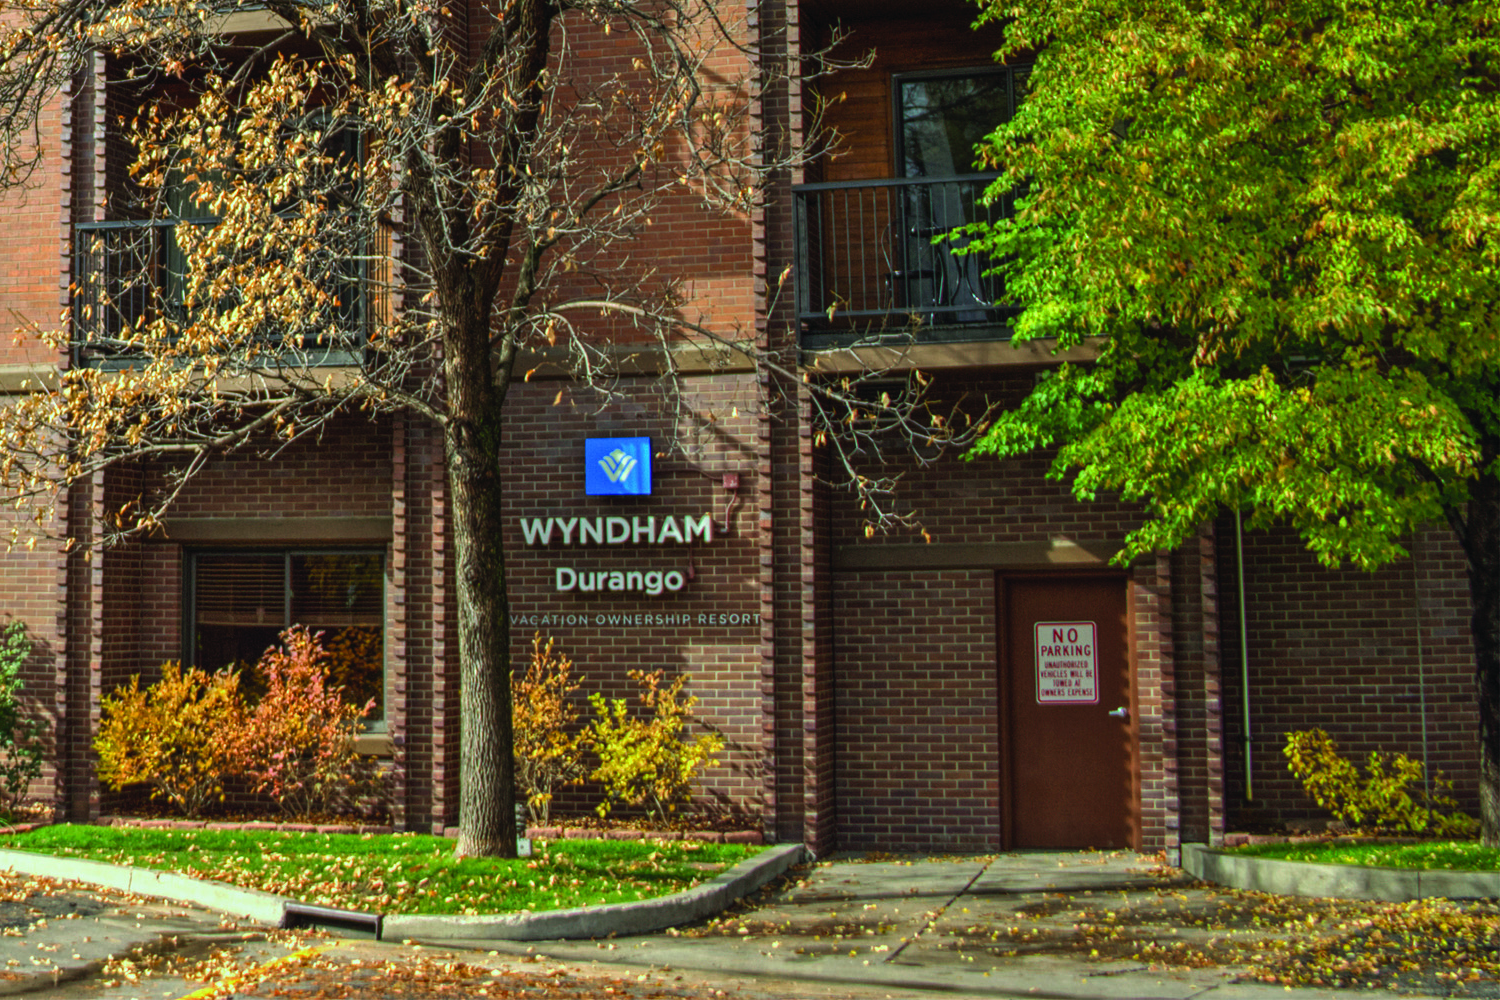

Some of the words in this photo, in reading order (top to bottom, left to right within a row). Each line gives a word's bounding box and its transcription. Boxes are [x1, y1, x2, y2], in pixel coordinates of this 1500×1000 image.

[520, 514, 713, 545] WYNDHAM
[555, 567, 684, 595] Durango
[509, 614, 588, 625] VACATION
[595, 614, 691, 625] OWNERSHIP
[698, 613, 761, 625] RESORT
[1052, 628, 1078, 643] NO
[1040, 645, 1091, 656] PARKING
[1044, 660, 1088, 669] UNAUTHORIZED
[1040, 670, 1068, 678] VEHICLES
[1070, 670, 1083, 678] WILL
[1085, 669, 1093, 678] BE
[1053, 679, 1072, 687] TOWED
[1074, 679, 1081, 687] AT
[1067, 687, 1093, 696] EXPENSE
